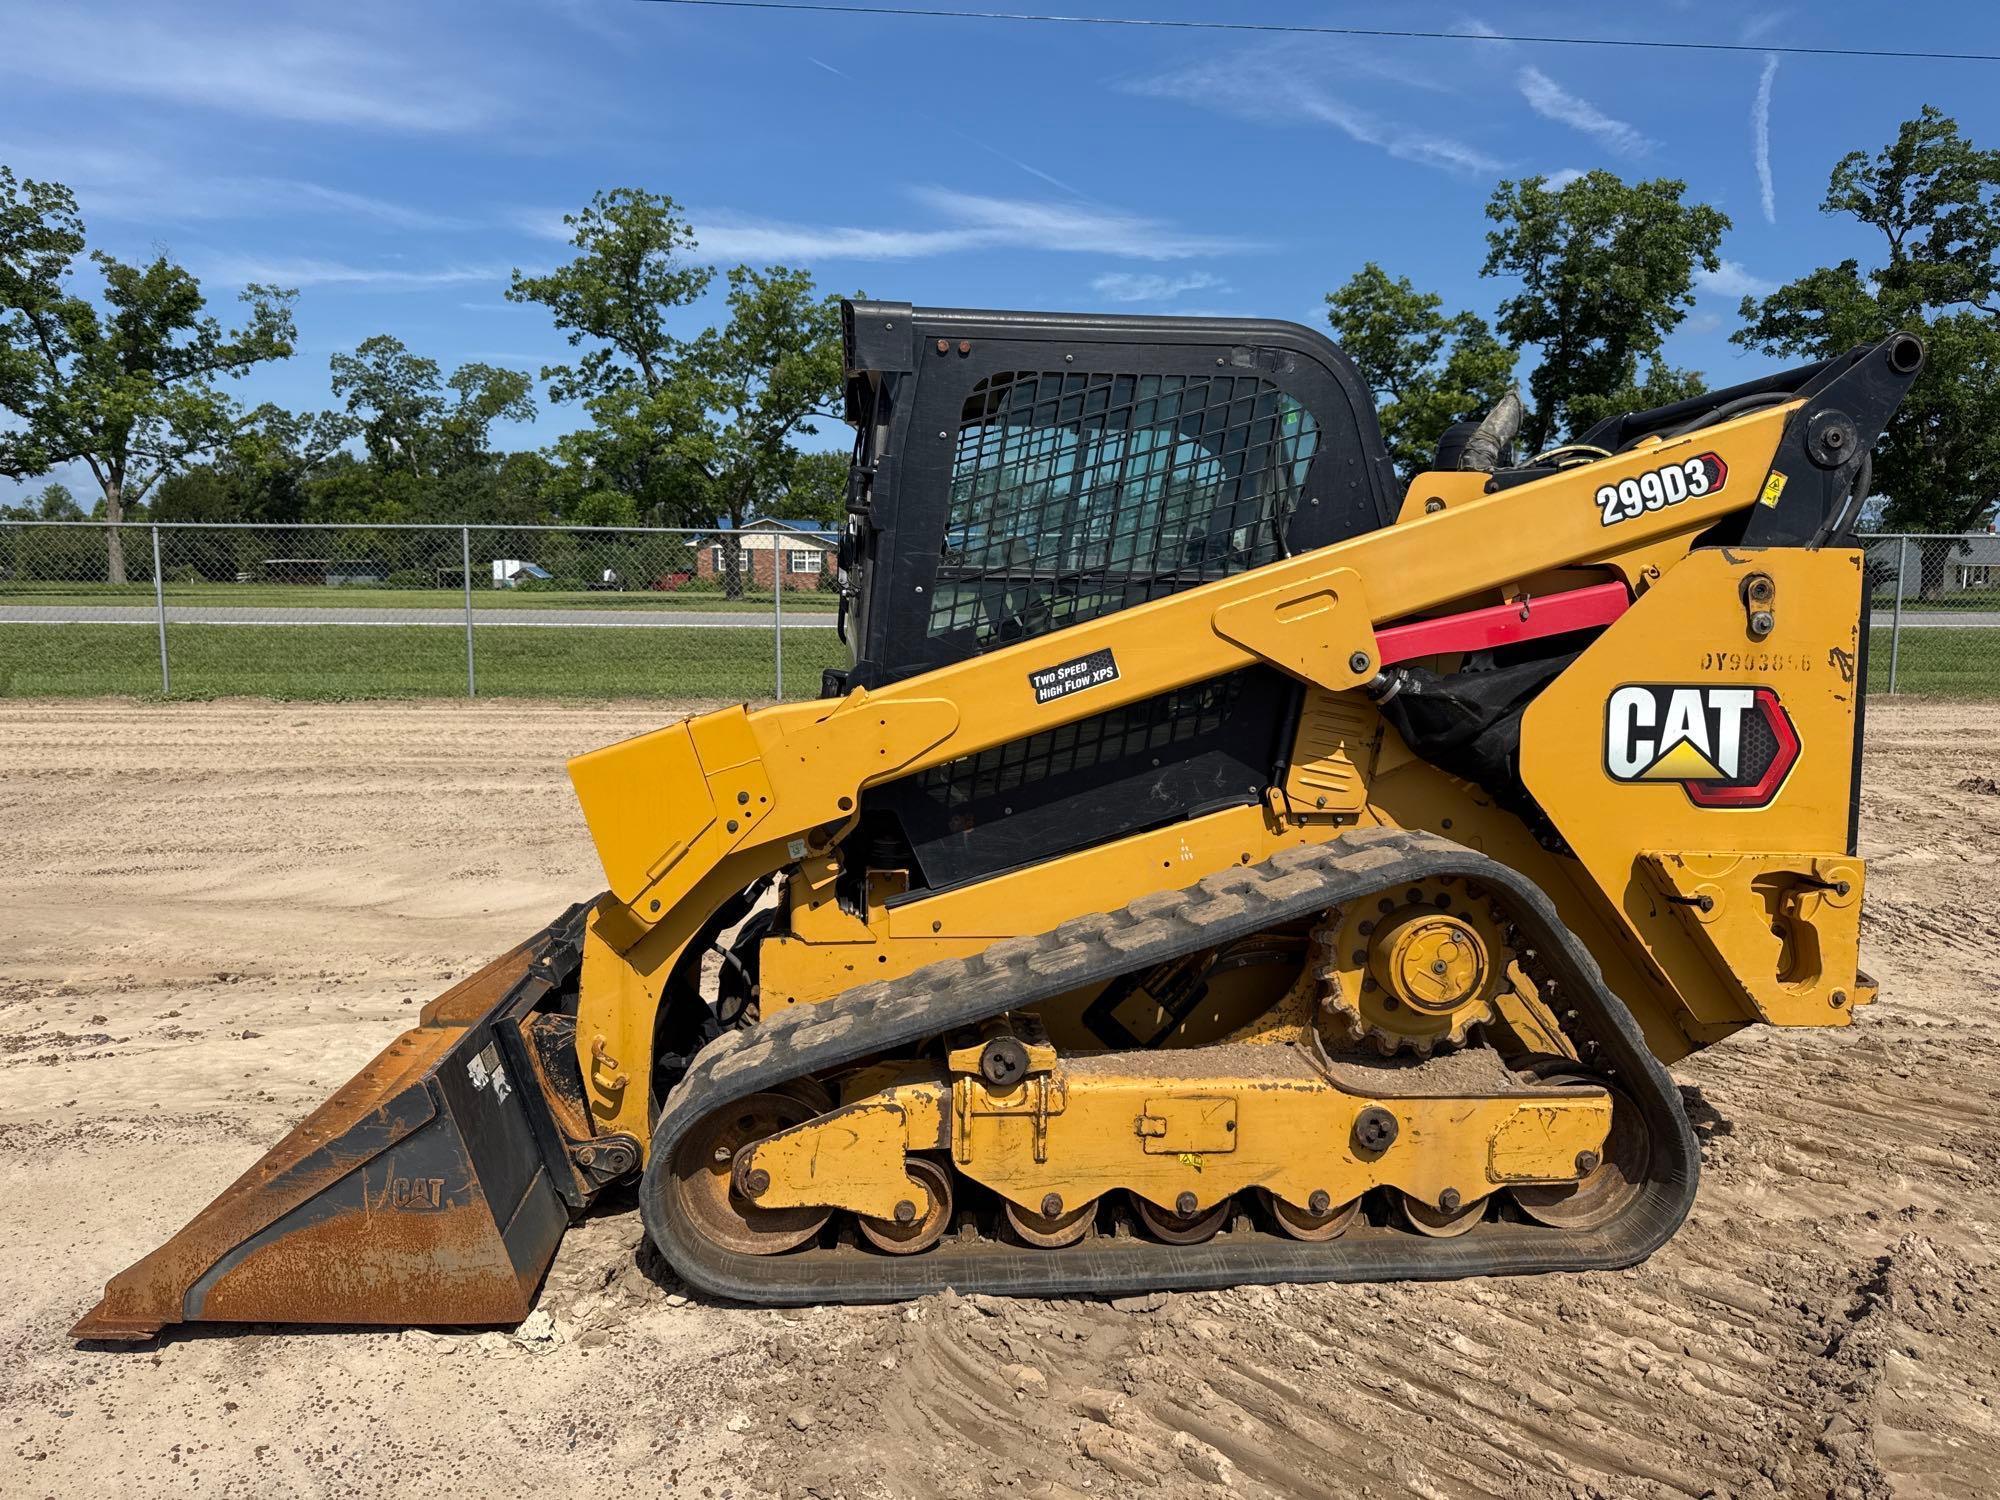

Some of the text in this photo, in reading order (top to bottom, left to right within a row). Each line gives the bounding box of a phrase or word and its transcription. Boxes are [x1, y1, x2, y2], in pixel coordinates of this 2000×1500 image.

[1597, 459, 1709, 525] 299D3
[1039, 667, 1113, 700] HIGH FLOW XPS
[1058, 663, 1087, 679] SPEED
[1609, 686, 1754, 779] CAT
[393, 1177, 445, 1208] CAT
